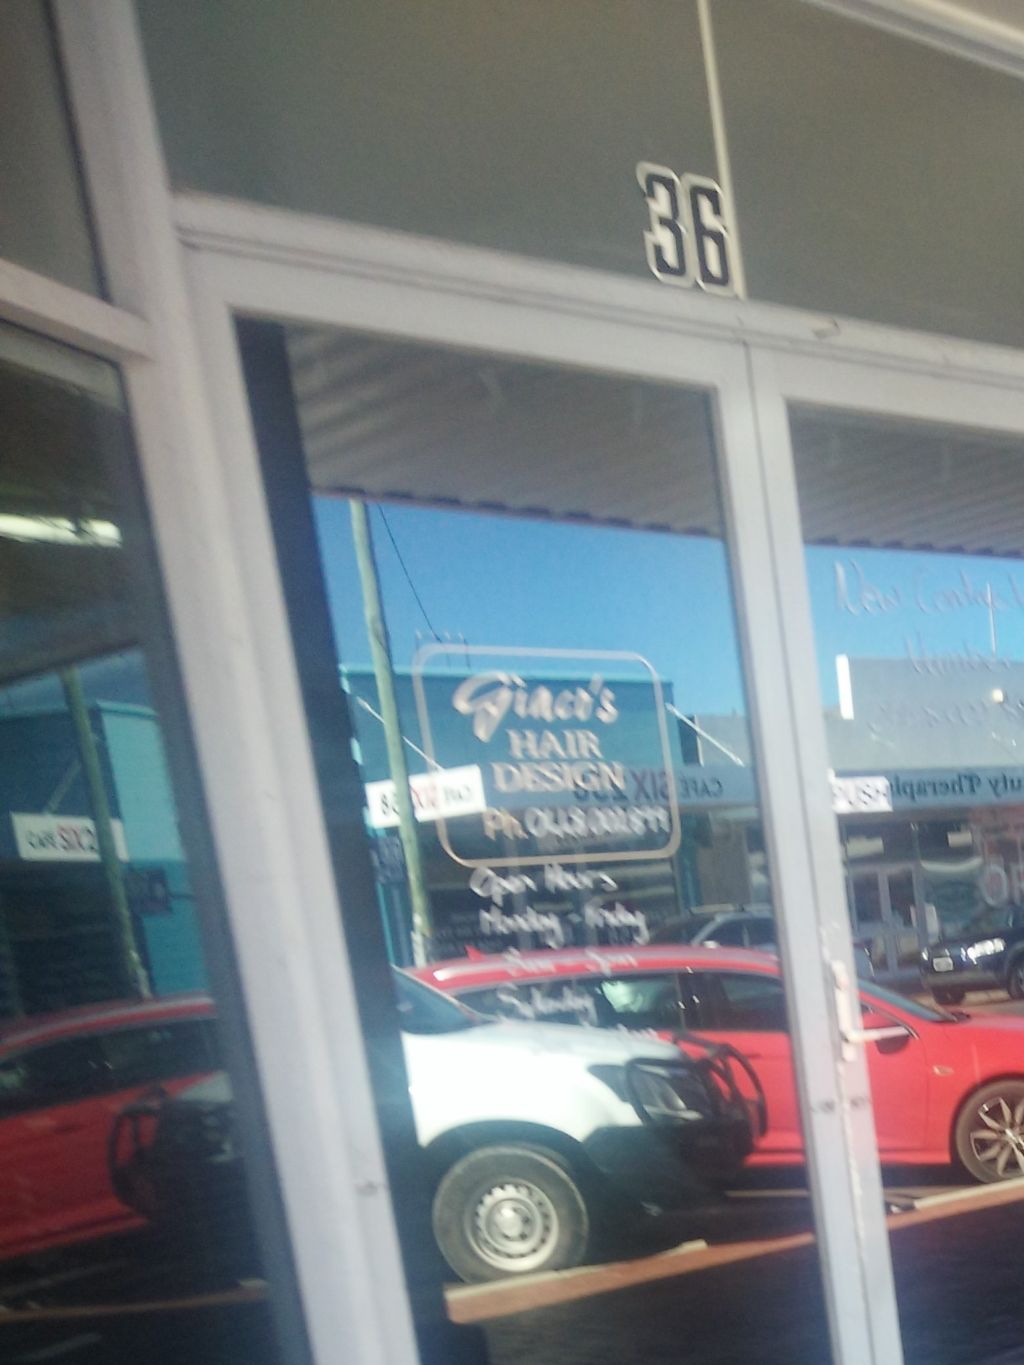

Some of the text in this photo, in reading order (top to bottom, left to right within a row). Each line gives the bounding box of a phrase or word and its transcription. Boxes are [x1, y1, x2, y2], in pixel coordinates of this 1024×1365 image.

[637, 162, 732, 294] 36
[505, 728, 604, 760] HAIR
[490, 761, 626, 793] DESIGN
